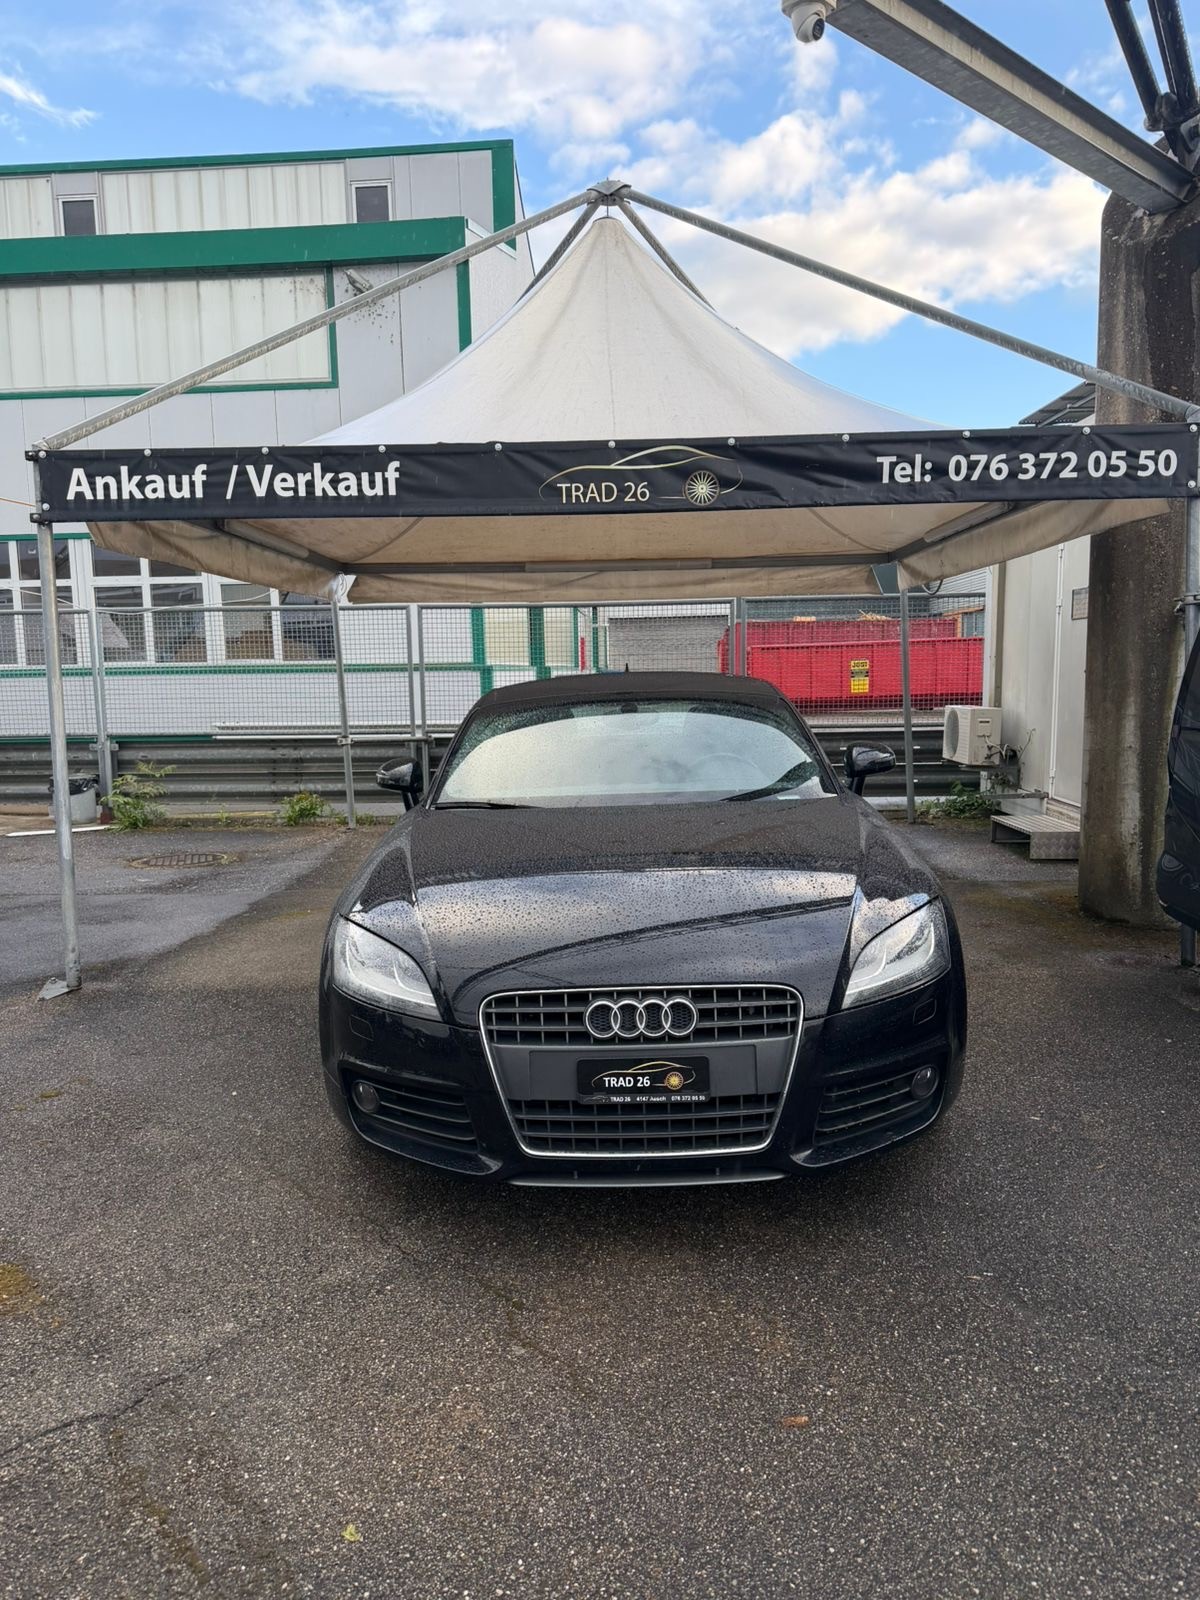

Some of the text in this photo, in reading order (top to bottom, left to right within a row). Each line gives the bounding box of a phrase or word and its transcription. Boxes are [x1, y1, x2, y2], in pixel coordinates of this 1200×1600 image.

[876, 449, 1178, 484] Tel: 076 372 05 50
[66, 464, 207, 500] Ankauf
[557, 481, 650, 504] TRAD 26
[603, 1076, 651, 1088] TRAD 26
